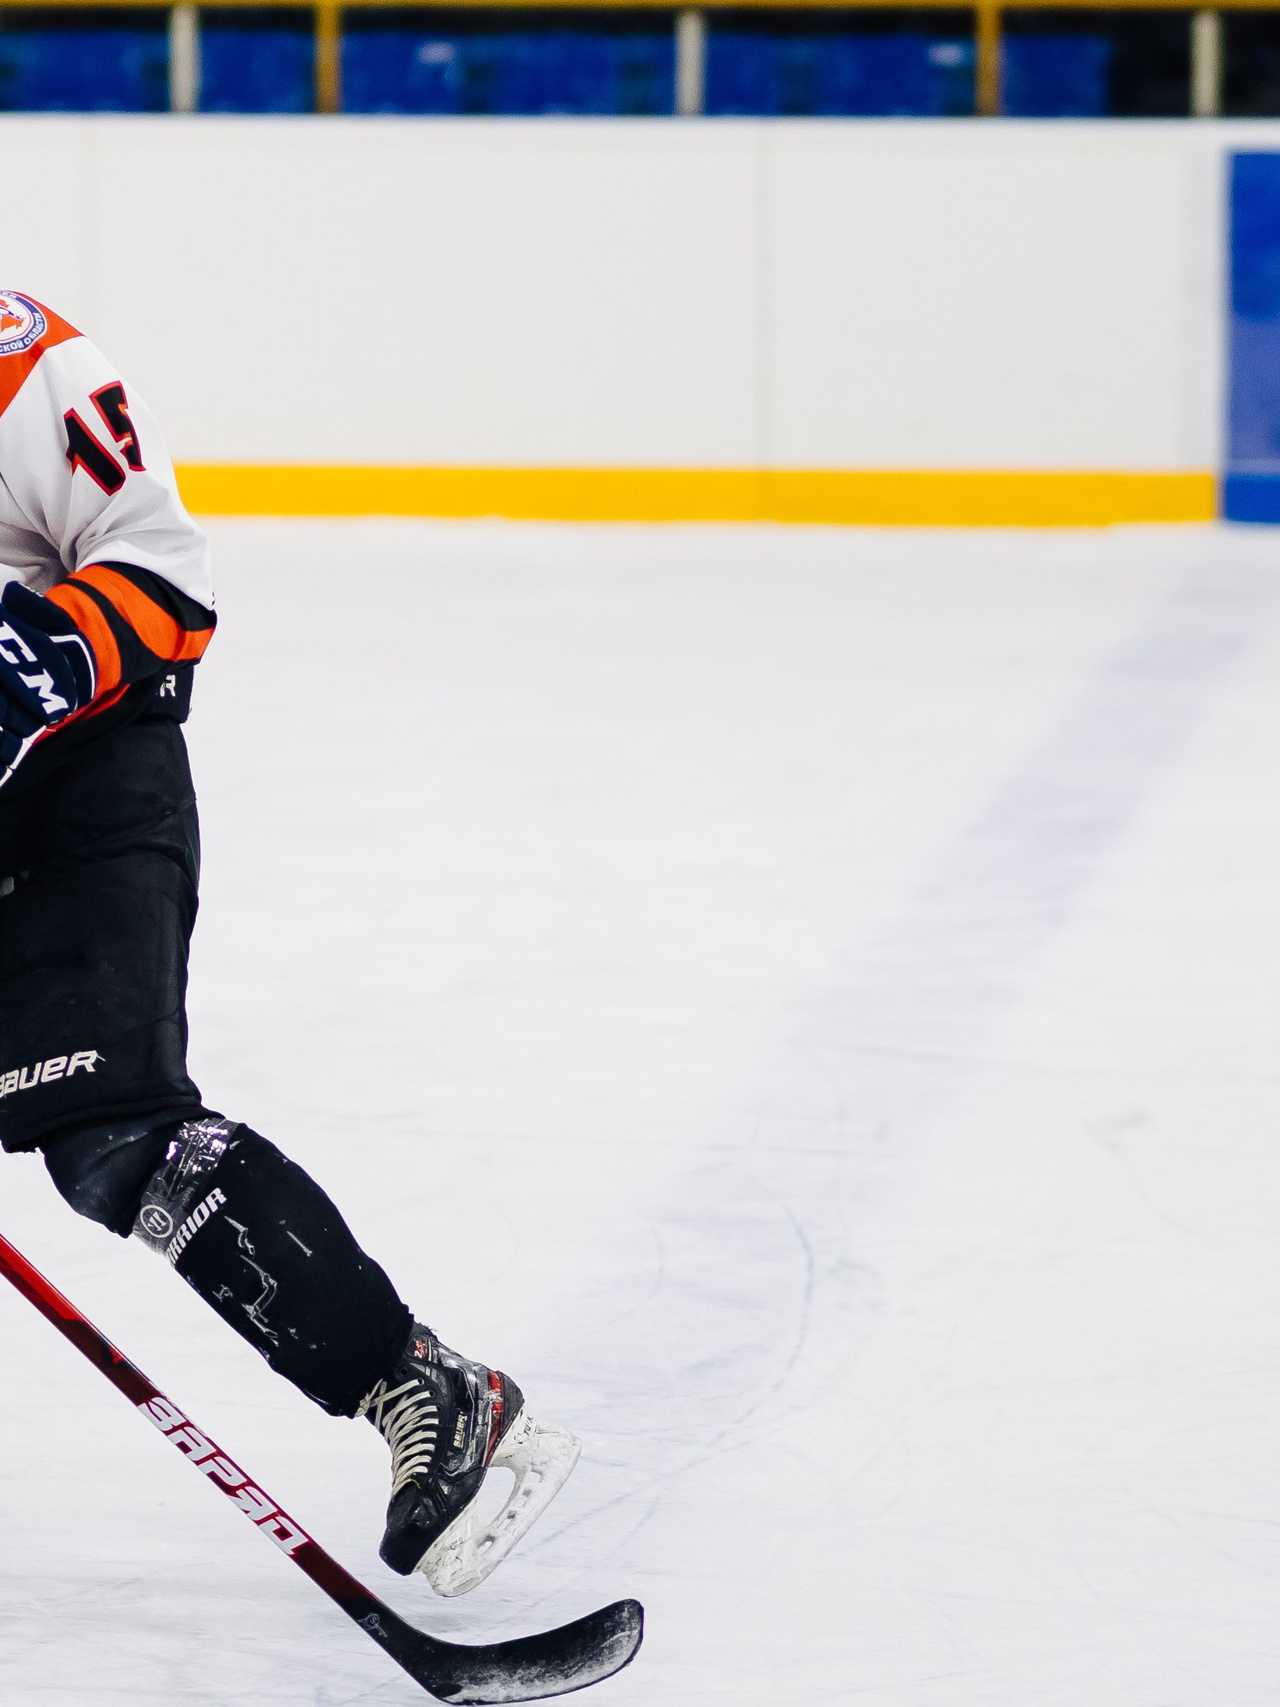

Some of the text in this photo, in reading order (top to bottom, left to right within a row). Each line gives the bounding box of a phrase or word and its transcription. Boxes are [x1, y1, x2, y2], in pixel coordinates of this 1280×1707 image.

[23, 312, 44, 346] ОБЛАСТИ
[63, 380, 147, 497] 15
[137, 1396, 311, 1555] ЗАРЯД
